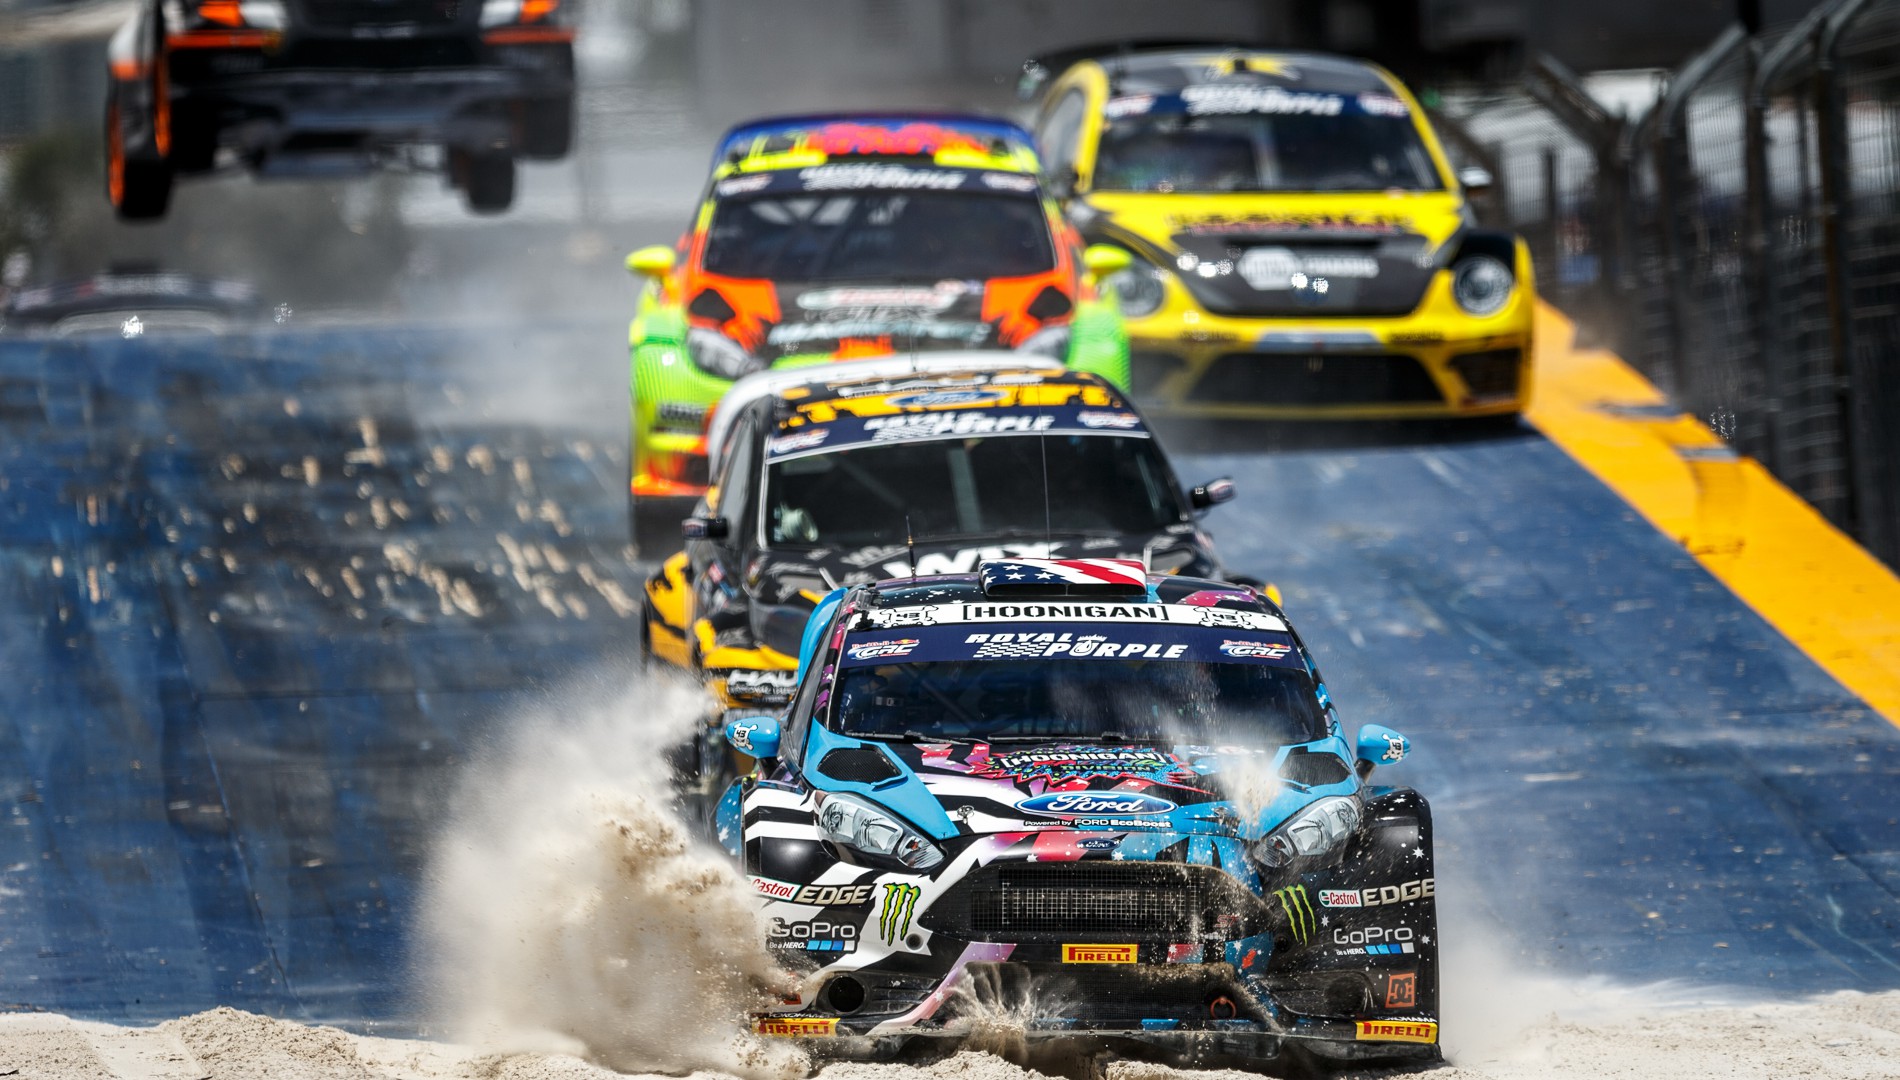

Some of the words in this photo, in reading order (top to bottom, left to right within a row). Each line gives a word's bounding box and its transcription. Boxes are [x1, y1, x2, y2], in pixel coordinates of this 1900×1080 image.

[965, 632, 1074, 644] ROYAL
[1042, 636, 1189, 659] PURPLE
[735, 729, 747, 739] 43
[1047, 793, 1146, 812] Ford
[1061, 819, 1073, 828] by
[1074, 818, 1109, 827] FORD
[1110, 818, 1173, 829] EcoBoost
[752, 878, 795, 899] Castrol
[794, 884, 875, 906] EDGE
[1361, 878, 1435, 907] EDGE
[1329, 891, 1360, 906] Castrol
[769, 918, 856, 939] GoPro
[1333, 926, 1414, 945] GoPro
[769, 942, 778, 950] Be
[1068, 947, 1131, 962] PIRELLI
[759, 1019, 831, 1035] PIRELLI
[1362, 1021, 1431, 1038] PIRELLI
